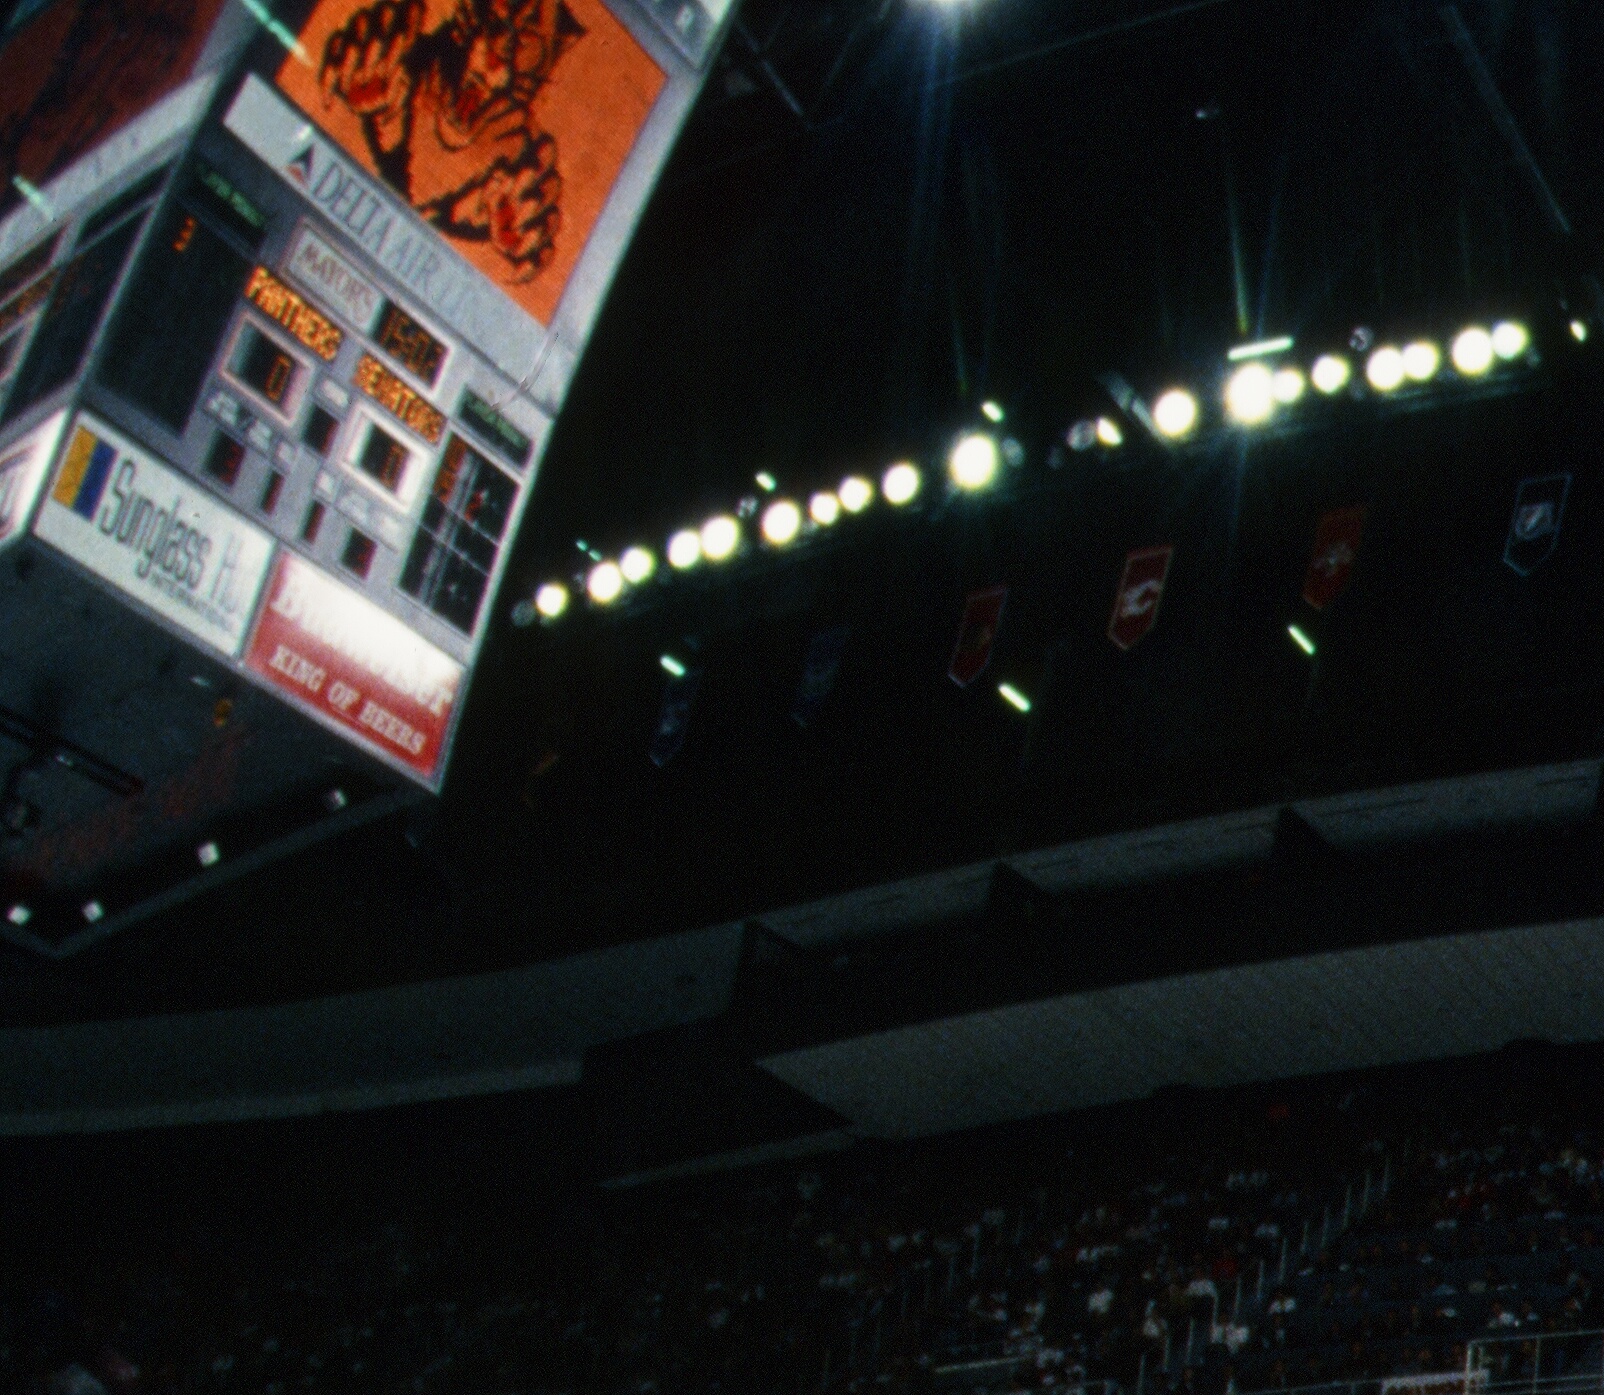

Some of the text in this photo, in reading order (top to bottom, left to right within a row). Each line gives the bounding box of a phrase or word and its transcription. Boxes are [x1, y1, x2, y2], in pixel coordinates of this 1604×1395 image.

[245, 266, 343, 361] PANTHERS
[356, 352, 446, 443] SENATORS
[99, 457, 213, 590] Sunglass
[269, 643, 427, 756] KING OF BEERS
